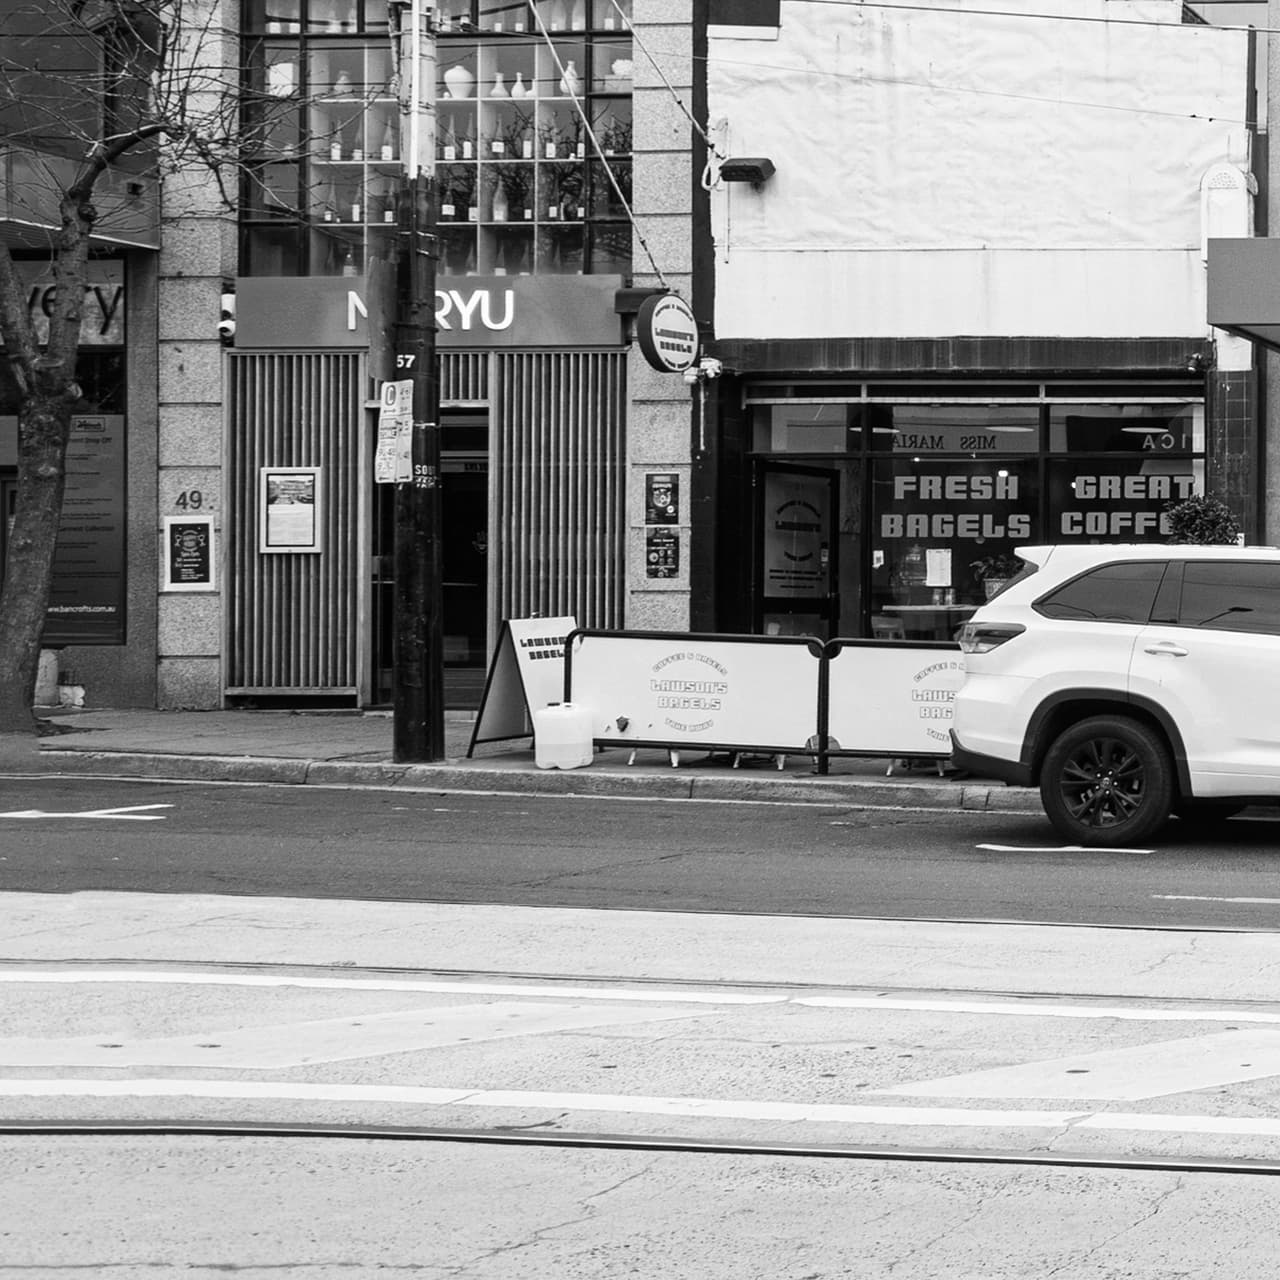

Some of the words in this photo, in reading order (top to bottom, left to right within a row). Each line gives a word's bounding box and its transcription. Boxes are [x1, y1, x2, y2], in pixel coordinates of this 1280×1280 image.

[396, 355, 416, 368] 57
[894, 475, 1019, 500] FRESH
[1075, 476, 1195, 499] GREAT
[175, 490, 202, 510] 49
[881, 514, 1031, 538] BAGELS
[650, 679, 728, 695] LAWSON'S
[657, 696, 721, 711] BAGELS
